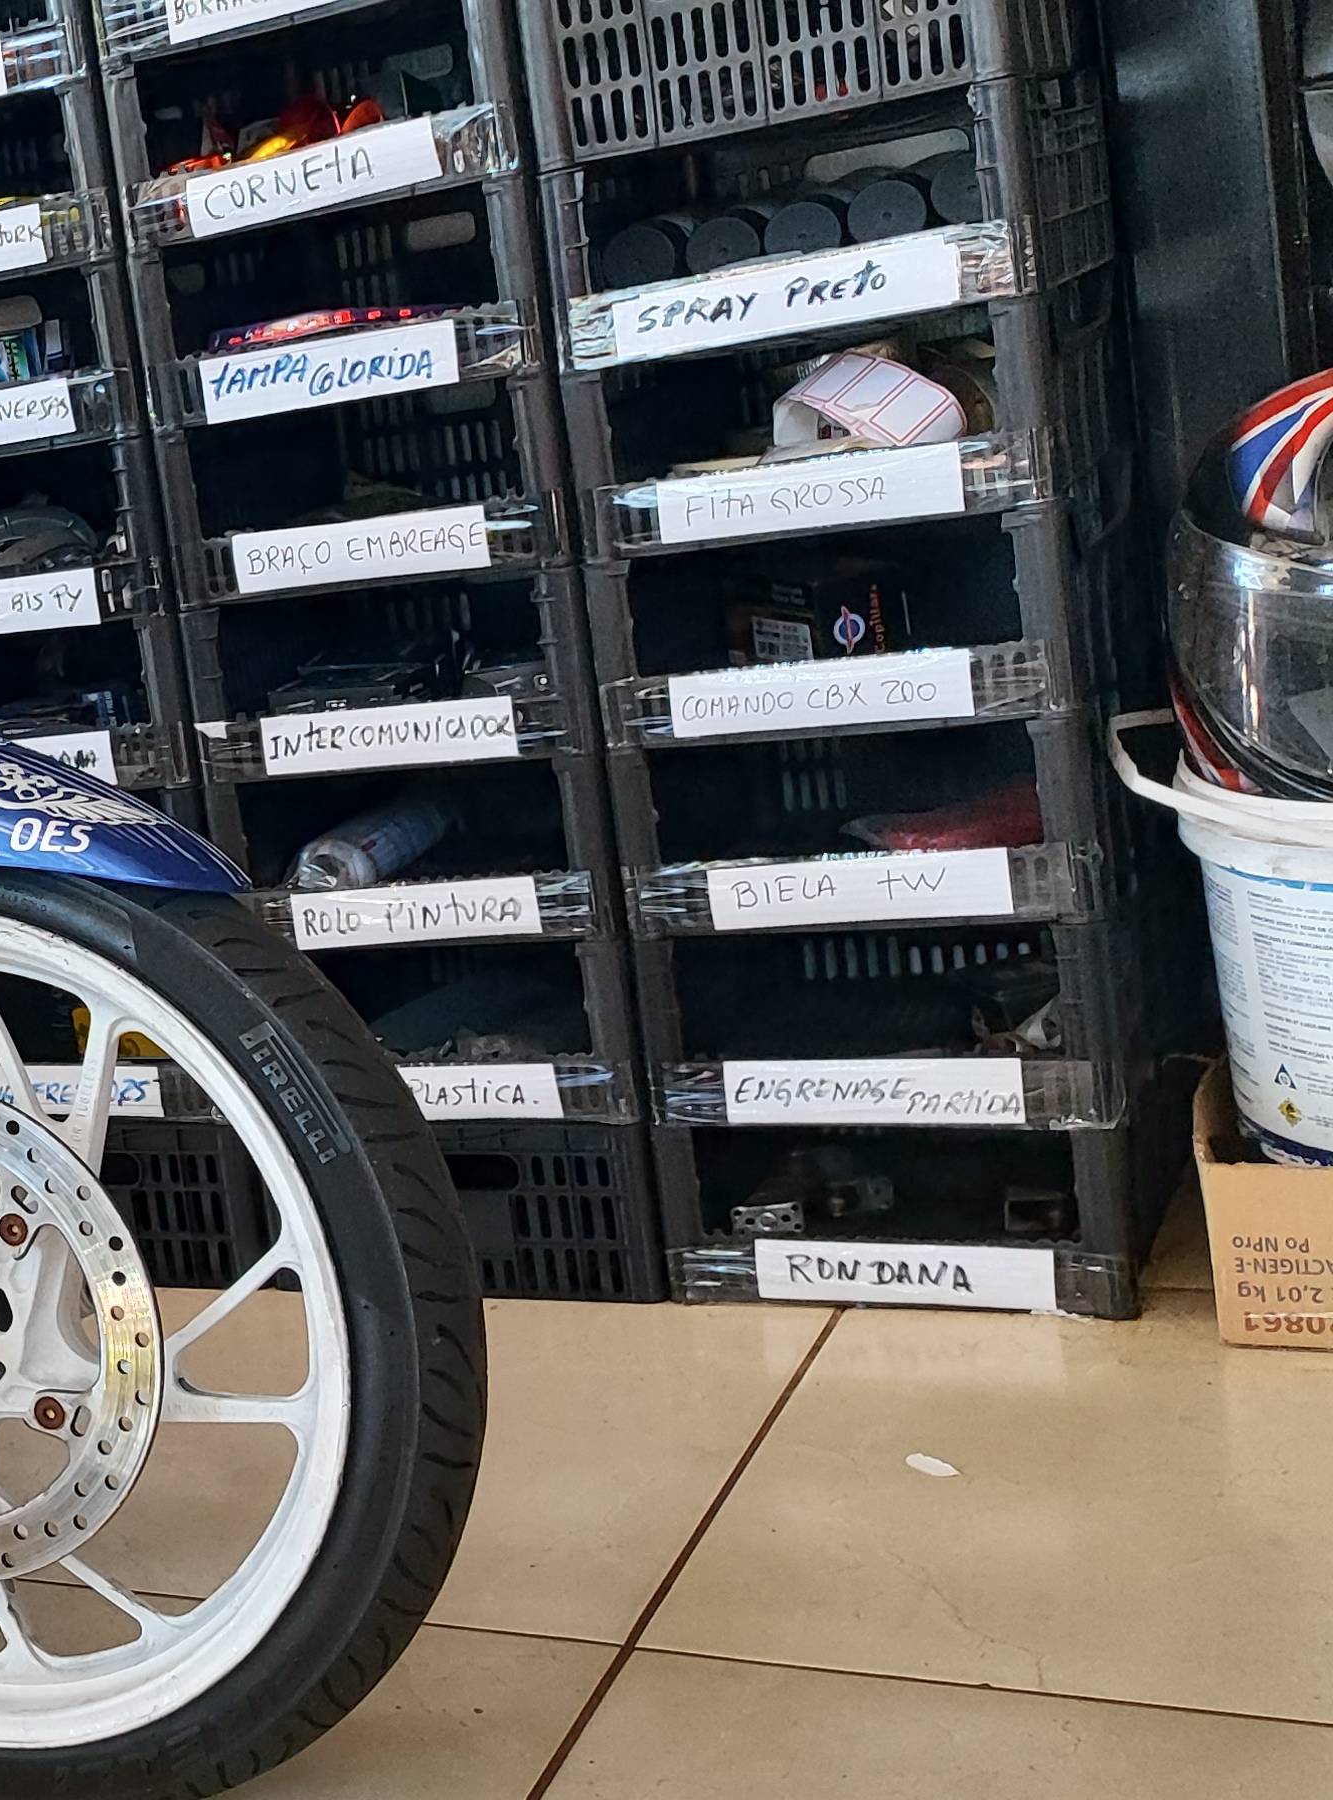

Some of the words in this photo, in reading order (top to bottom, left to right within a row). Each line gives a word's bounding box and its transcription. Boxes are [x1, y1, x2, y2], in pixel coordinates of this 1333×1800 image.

[637, 292, 758, 334] SPRAY
[770, 476, 886, 516] GROSSA
[247, 541, 331, 574] BRAÇO
[346, 521, 486, 561] EMBREAGE
[12, 591, 43, 613] BIS
[682, 691, 793, 721] COMANDO
[808, 682, 867, 709] CBX
[881, 680, 936, 704] 200
[731, 874, 837, 909] BIELA
[303, 908, 361, 937] ROLO
[238, 1021, 352, 1165] PIRELLI
[1237, 1281, 1266, 1303] kg
[1276, 1285, 1324, 1303] 2,01
[1244, 1311, 1333, 1335] 0861
